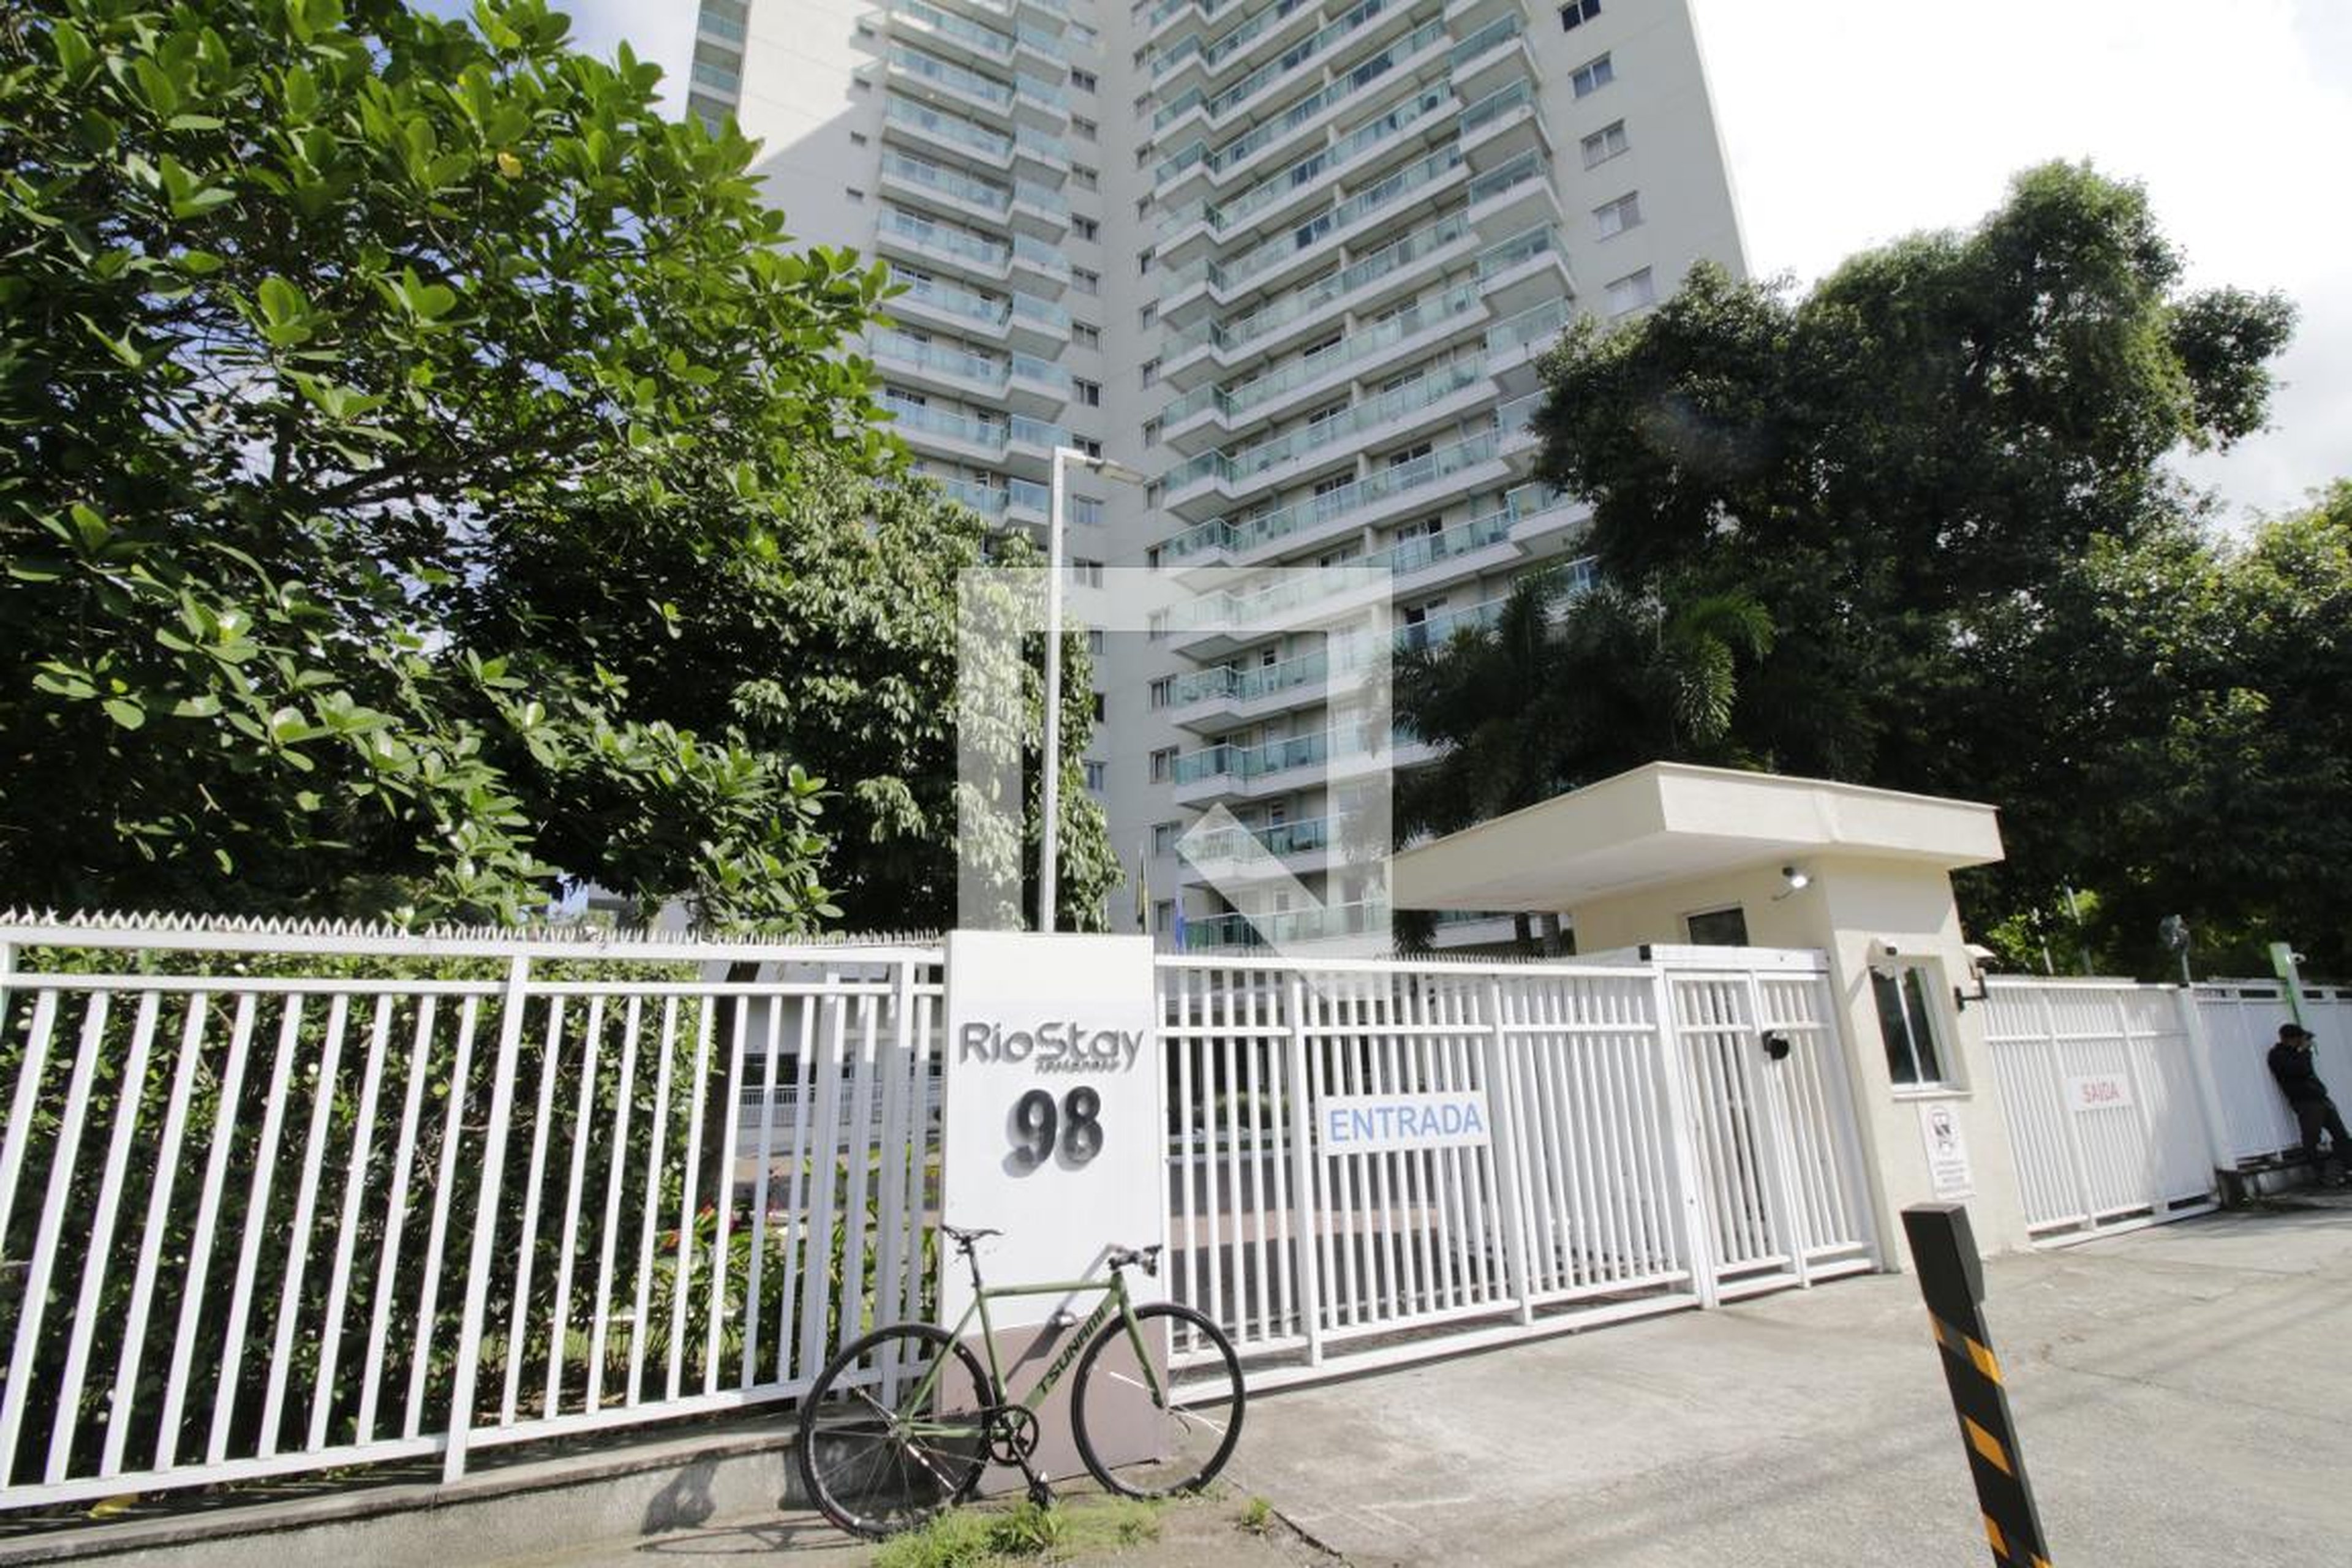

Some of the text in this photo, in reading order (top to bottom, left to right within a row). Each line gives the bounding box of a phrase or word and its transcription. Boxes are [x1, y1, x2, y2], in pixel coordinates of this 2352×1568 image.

[959, 1022, 1144, 1073] RioStay
[1012, 1086, 1104, 1166] 98
[1329, 1102, 1483, 1142] ENTRADA
[1036, 1306, 1106, 1394] TSUNAMI
